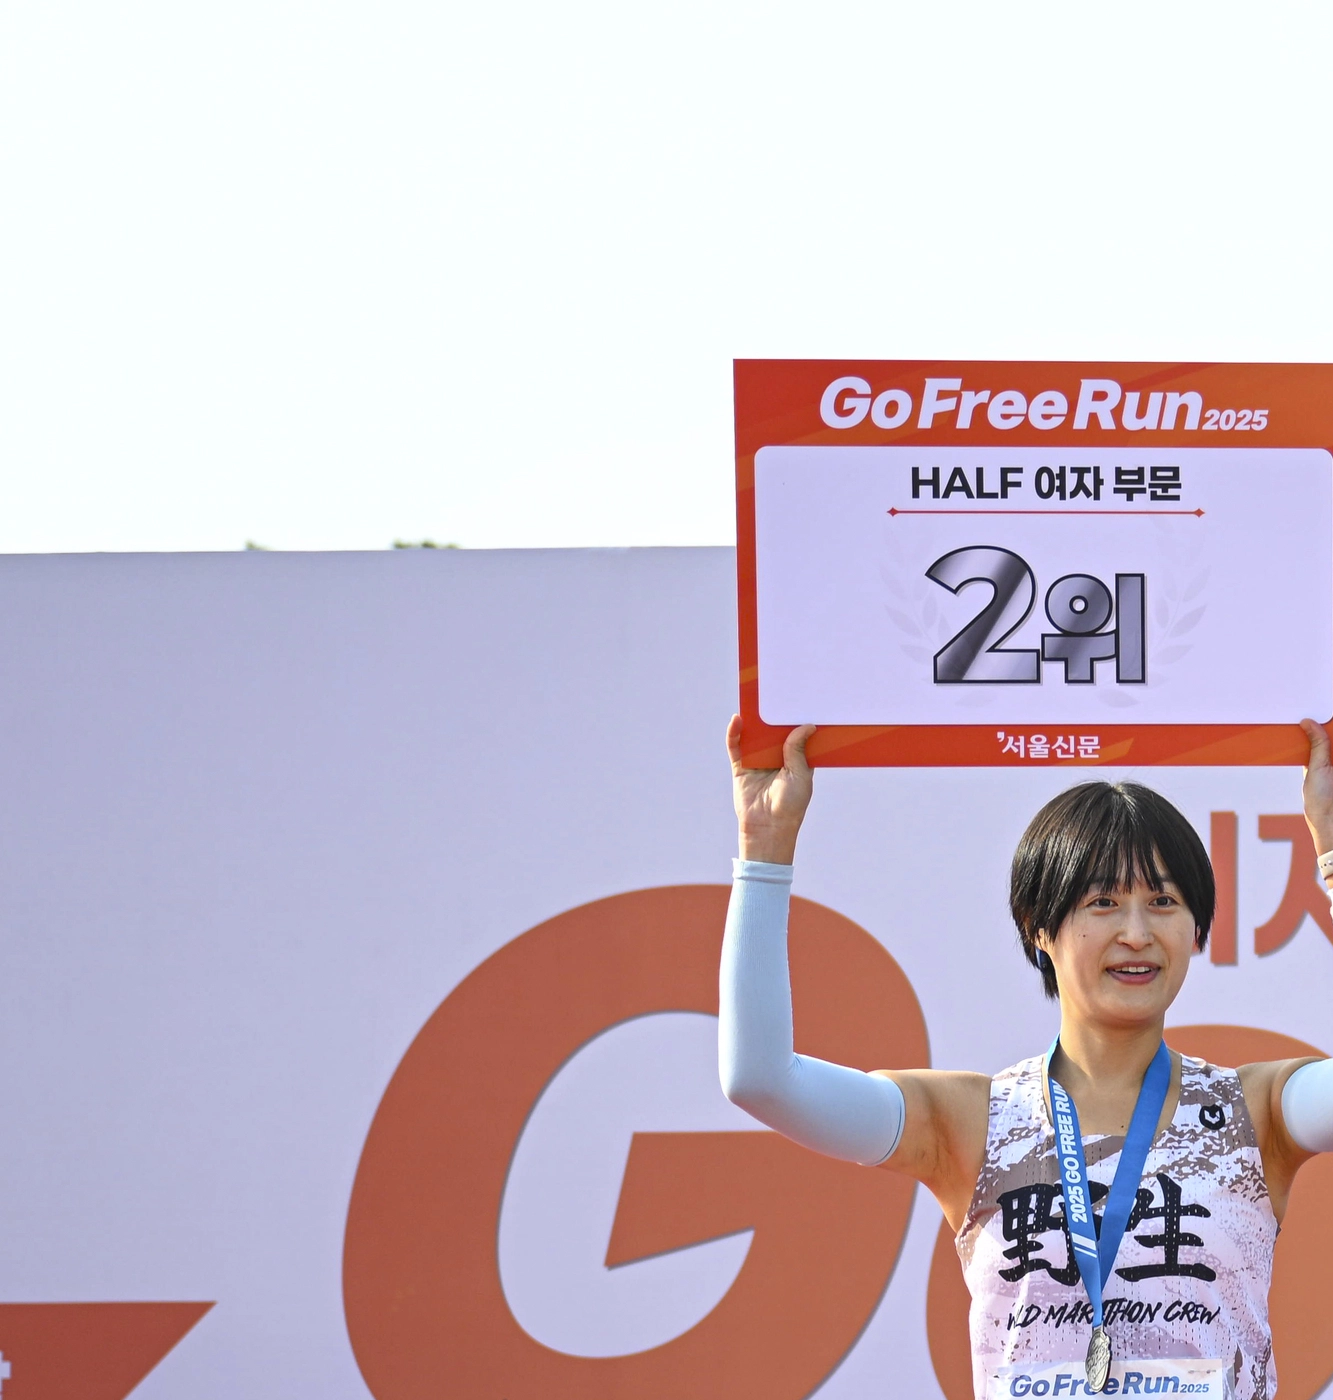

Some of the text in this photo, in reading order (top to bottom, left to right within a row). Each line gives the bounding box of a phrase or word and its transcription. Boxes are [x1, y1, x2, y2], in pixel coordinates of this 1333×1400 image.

[1202, 409, 1268, 431] 2025
[912, 466, 1181, 502] HALF 여자 부문
[925, 546, 1145, 683] 2위
[1057, 1113, 1078, 1155] FREE
[1063, 1159, 1082, 1184] GO
[1068, 1185, 1087, 1224] 2025
[997, 1173, 1216, 1286] 野生
[1163, 1301, 1220, 1325] CREW
[1180, 1384, 1209, 1393] 2025
